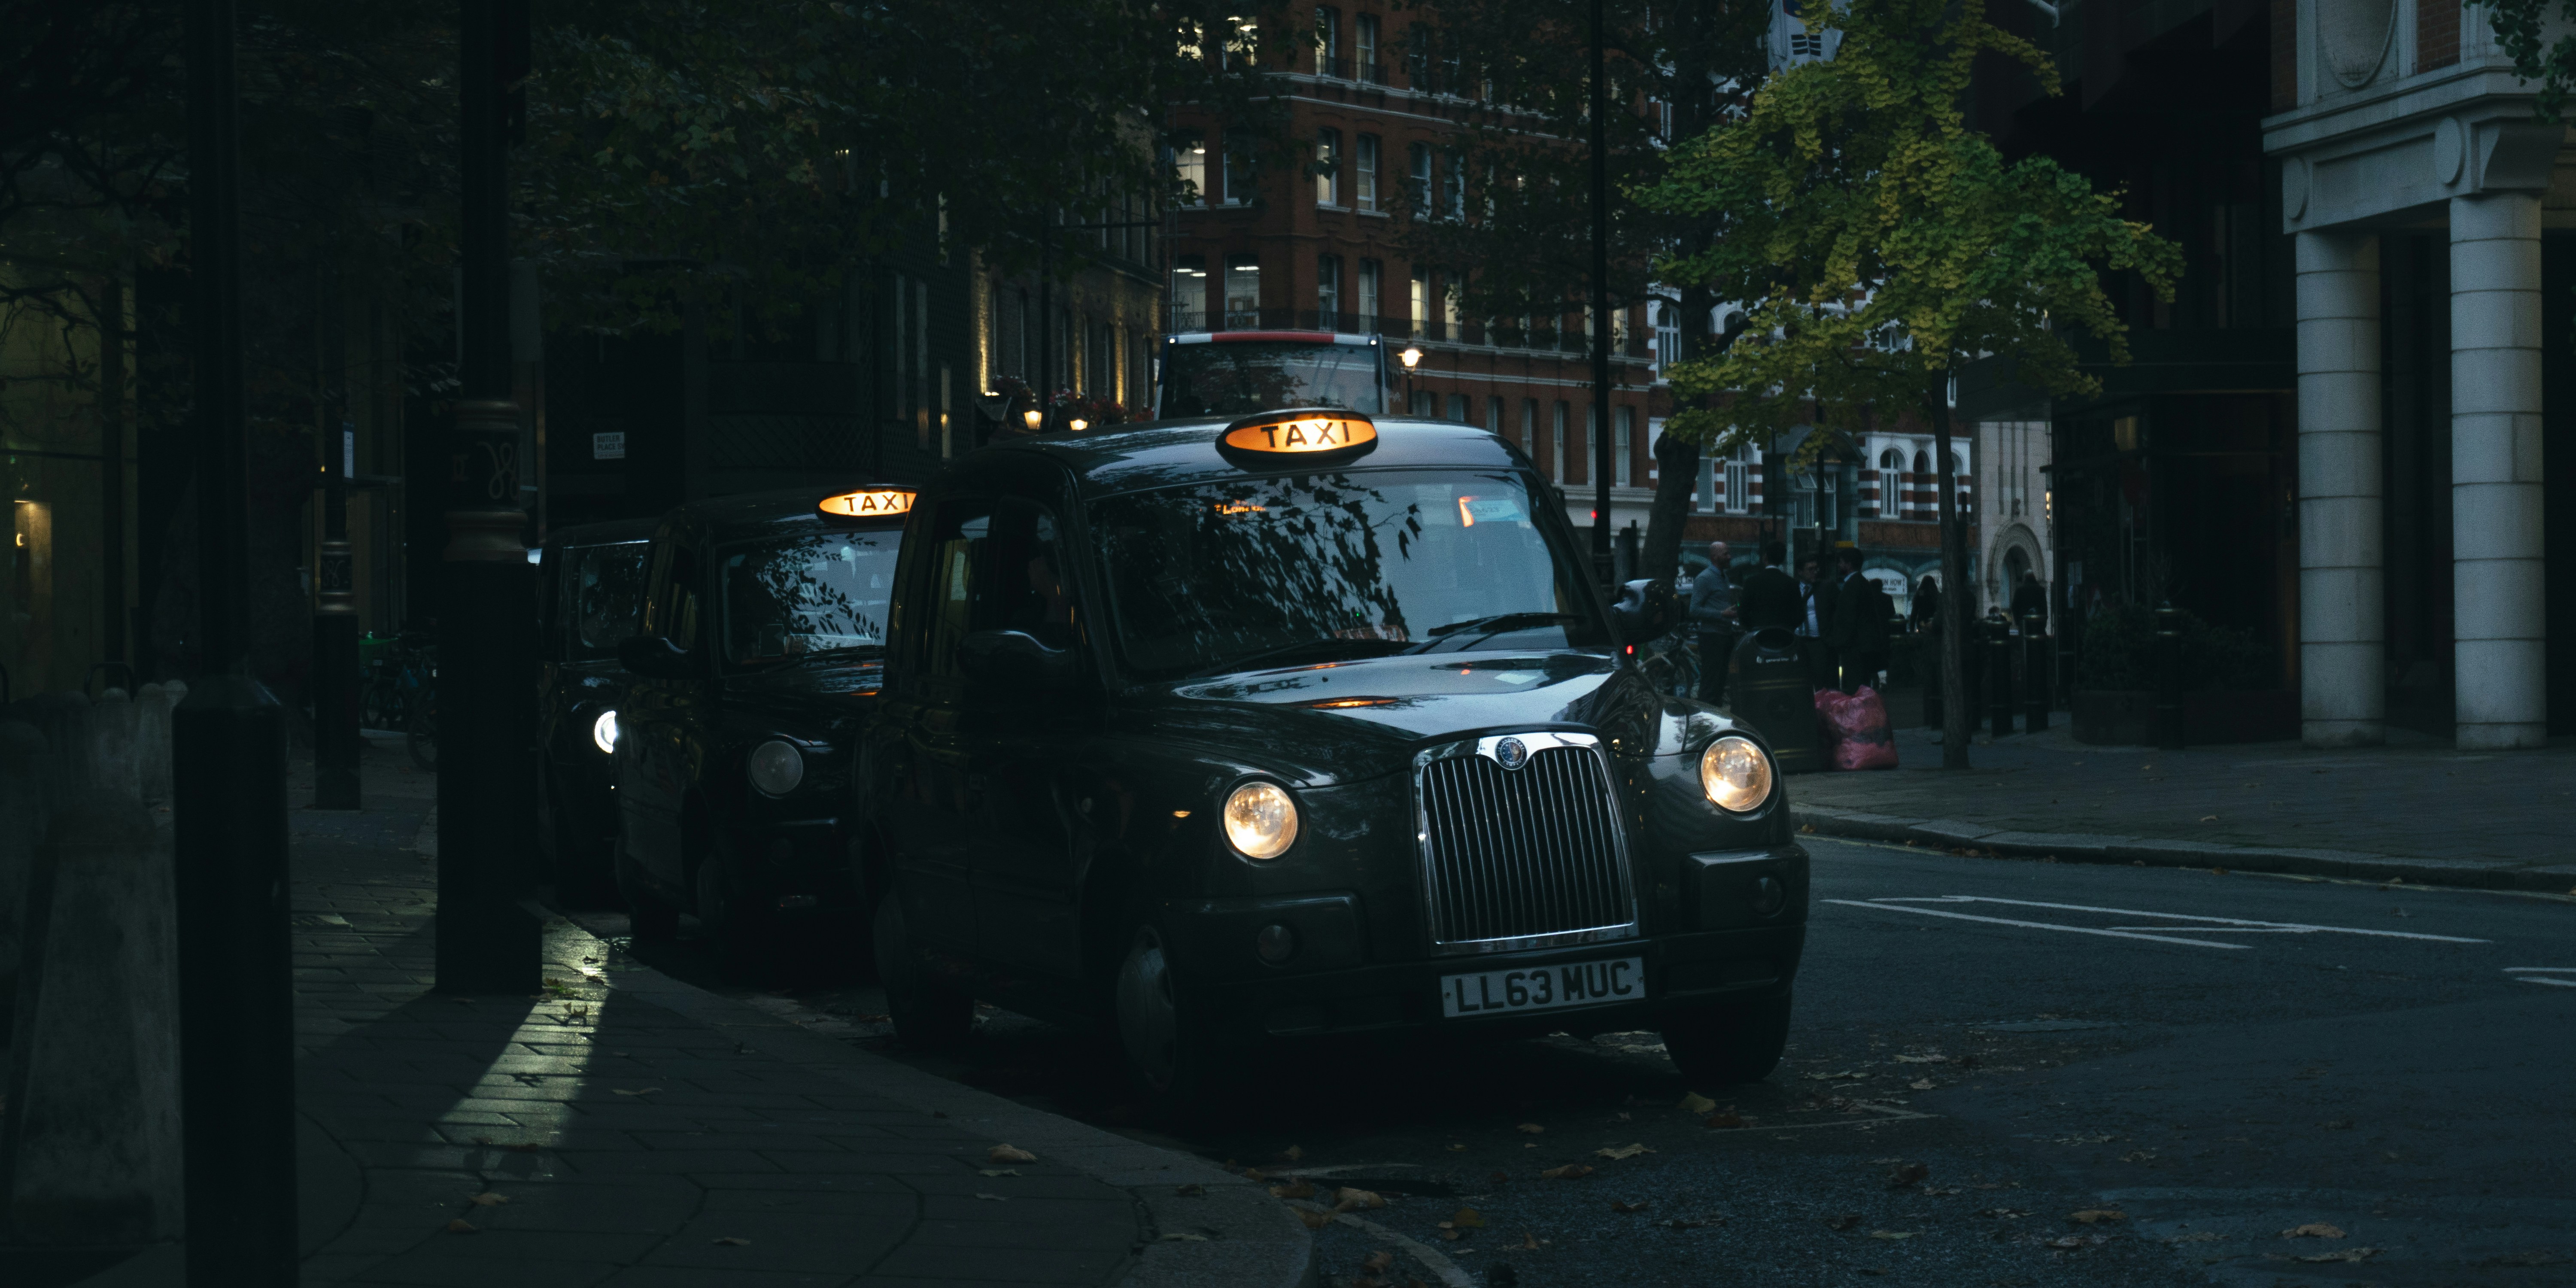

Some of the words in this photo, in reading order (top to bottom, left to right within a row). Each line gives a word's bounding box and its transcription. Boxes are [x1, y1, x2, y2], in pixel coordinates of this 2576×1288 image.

[1260, 422, 1350, 448] TAXI
[844, 494, 908, 512] TAXI
[1455, 970, 1552, 1012] LL63
[1561, 961, 1632, 1001] MUC
